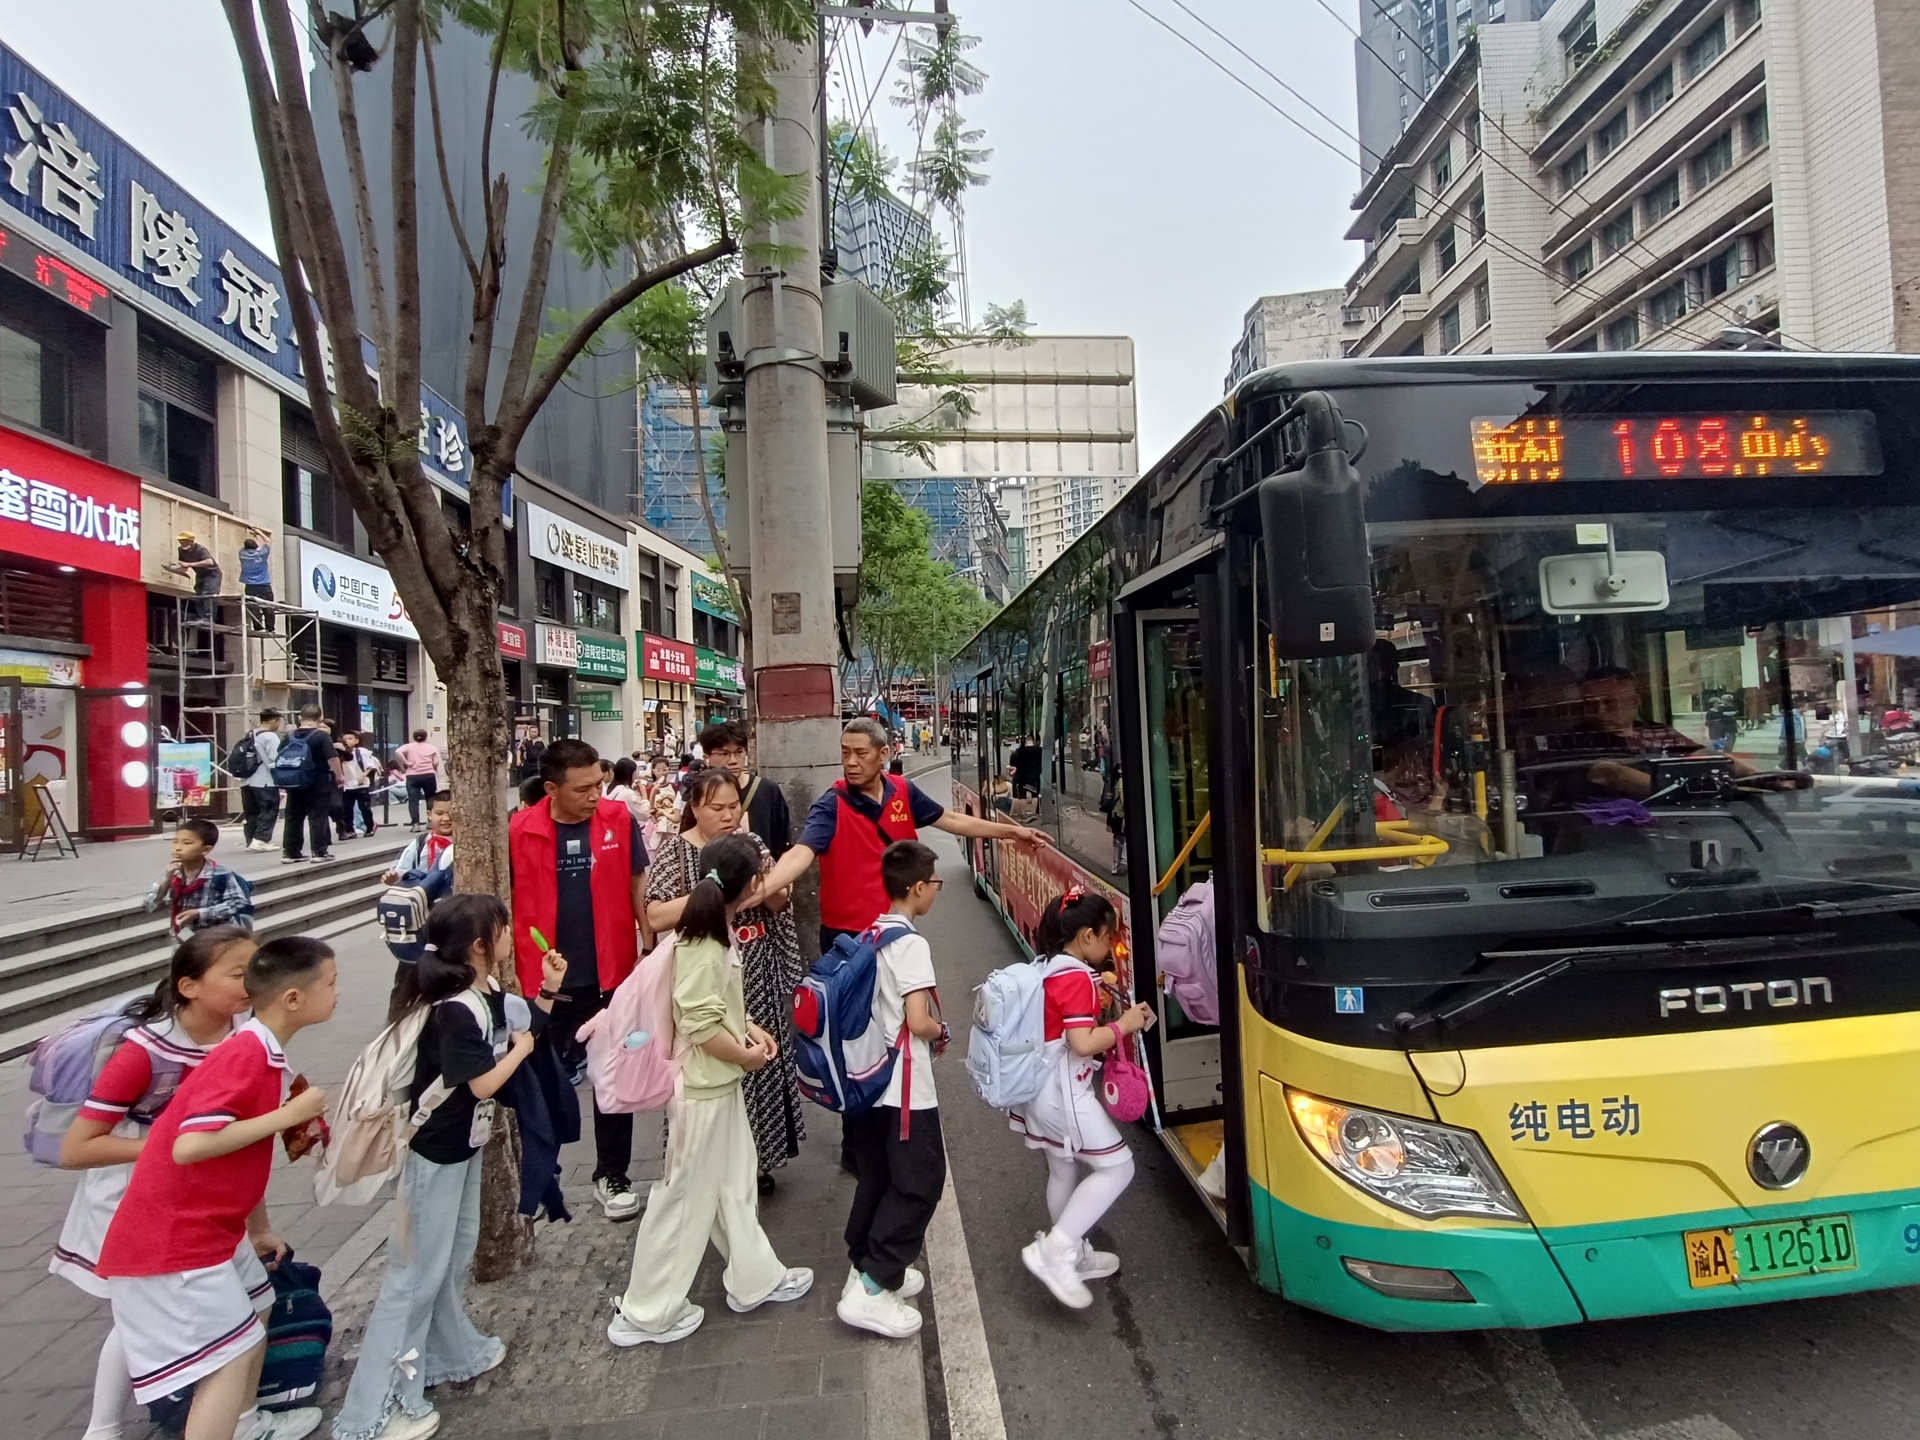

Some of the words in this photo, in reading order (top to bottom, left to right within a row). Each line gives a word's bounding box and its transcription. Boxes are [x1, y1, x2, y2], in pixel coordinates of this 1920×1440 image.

[1612, 417, 1729, 475] 108
[0, 468, 140, 550] 蜜雪冰城
[340, 576, 379, 600] 中国广电
[340, 595, 355, 605] China
[357, 598, 379, 611] Broadnet
[388, 592, 412, 622] 5
[502, 631, 521, 648] 美宜佳
[584, 643, 626, 664] 涪陵冠佳口腔诊所
[1659, 976, 1833, 1018] FOTON
[1509, 1095, 1641, 1142] 纯电动
